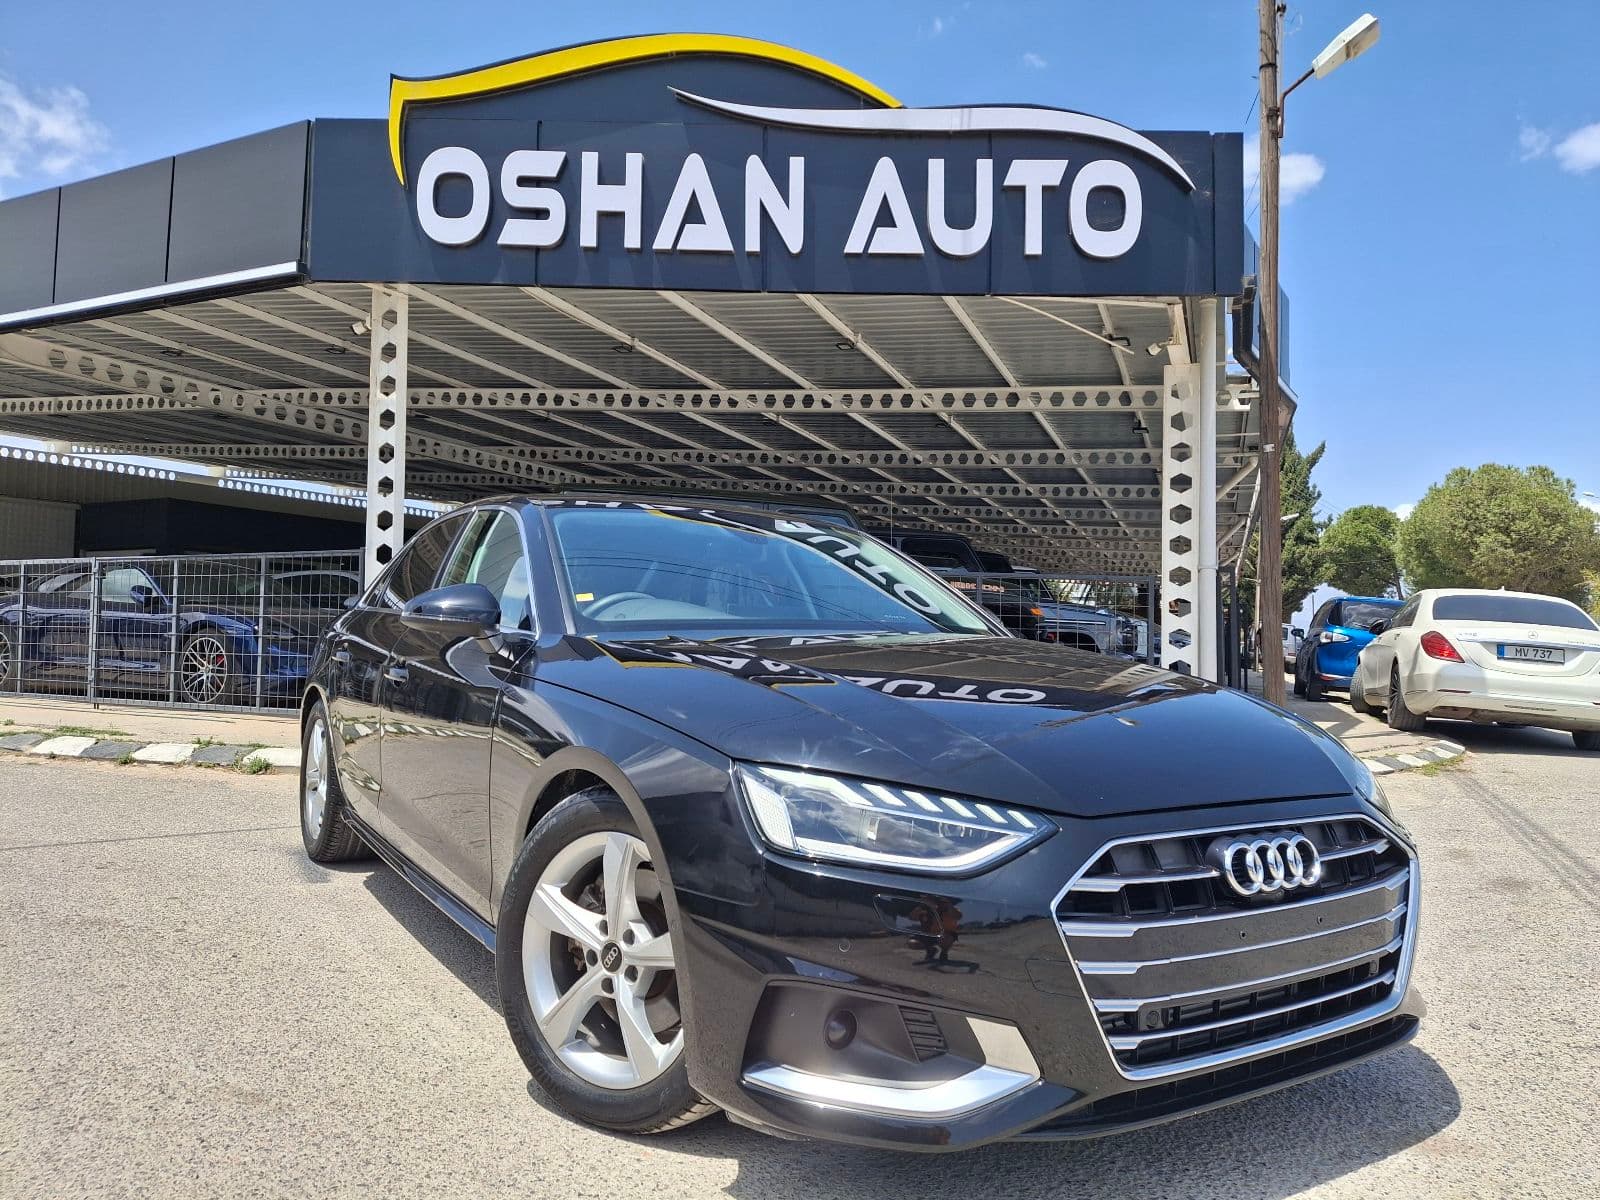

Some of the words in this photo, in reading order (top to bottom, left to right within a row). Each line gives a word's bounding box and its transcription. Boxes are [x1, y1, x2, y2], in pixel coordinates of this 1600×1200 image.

[417, 146, 805, 254] OSHAN
[843, 156, 1143, 258] AUTO
[1515, 647, 1529, 657] MV
[1532, 648, 1553, 659] 737
